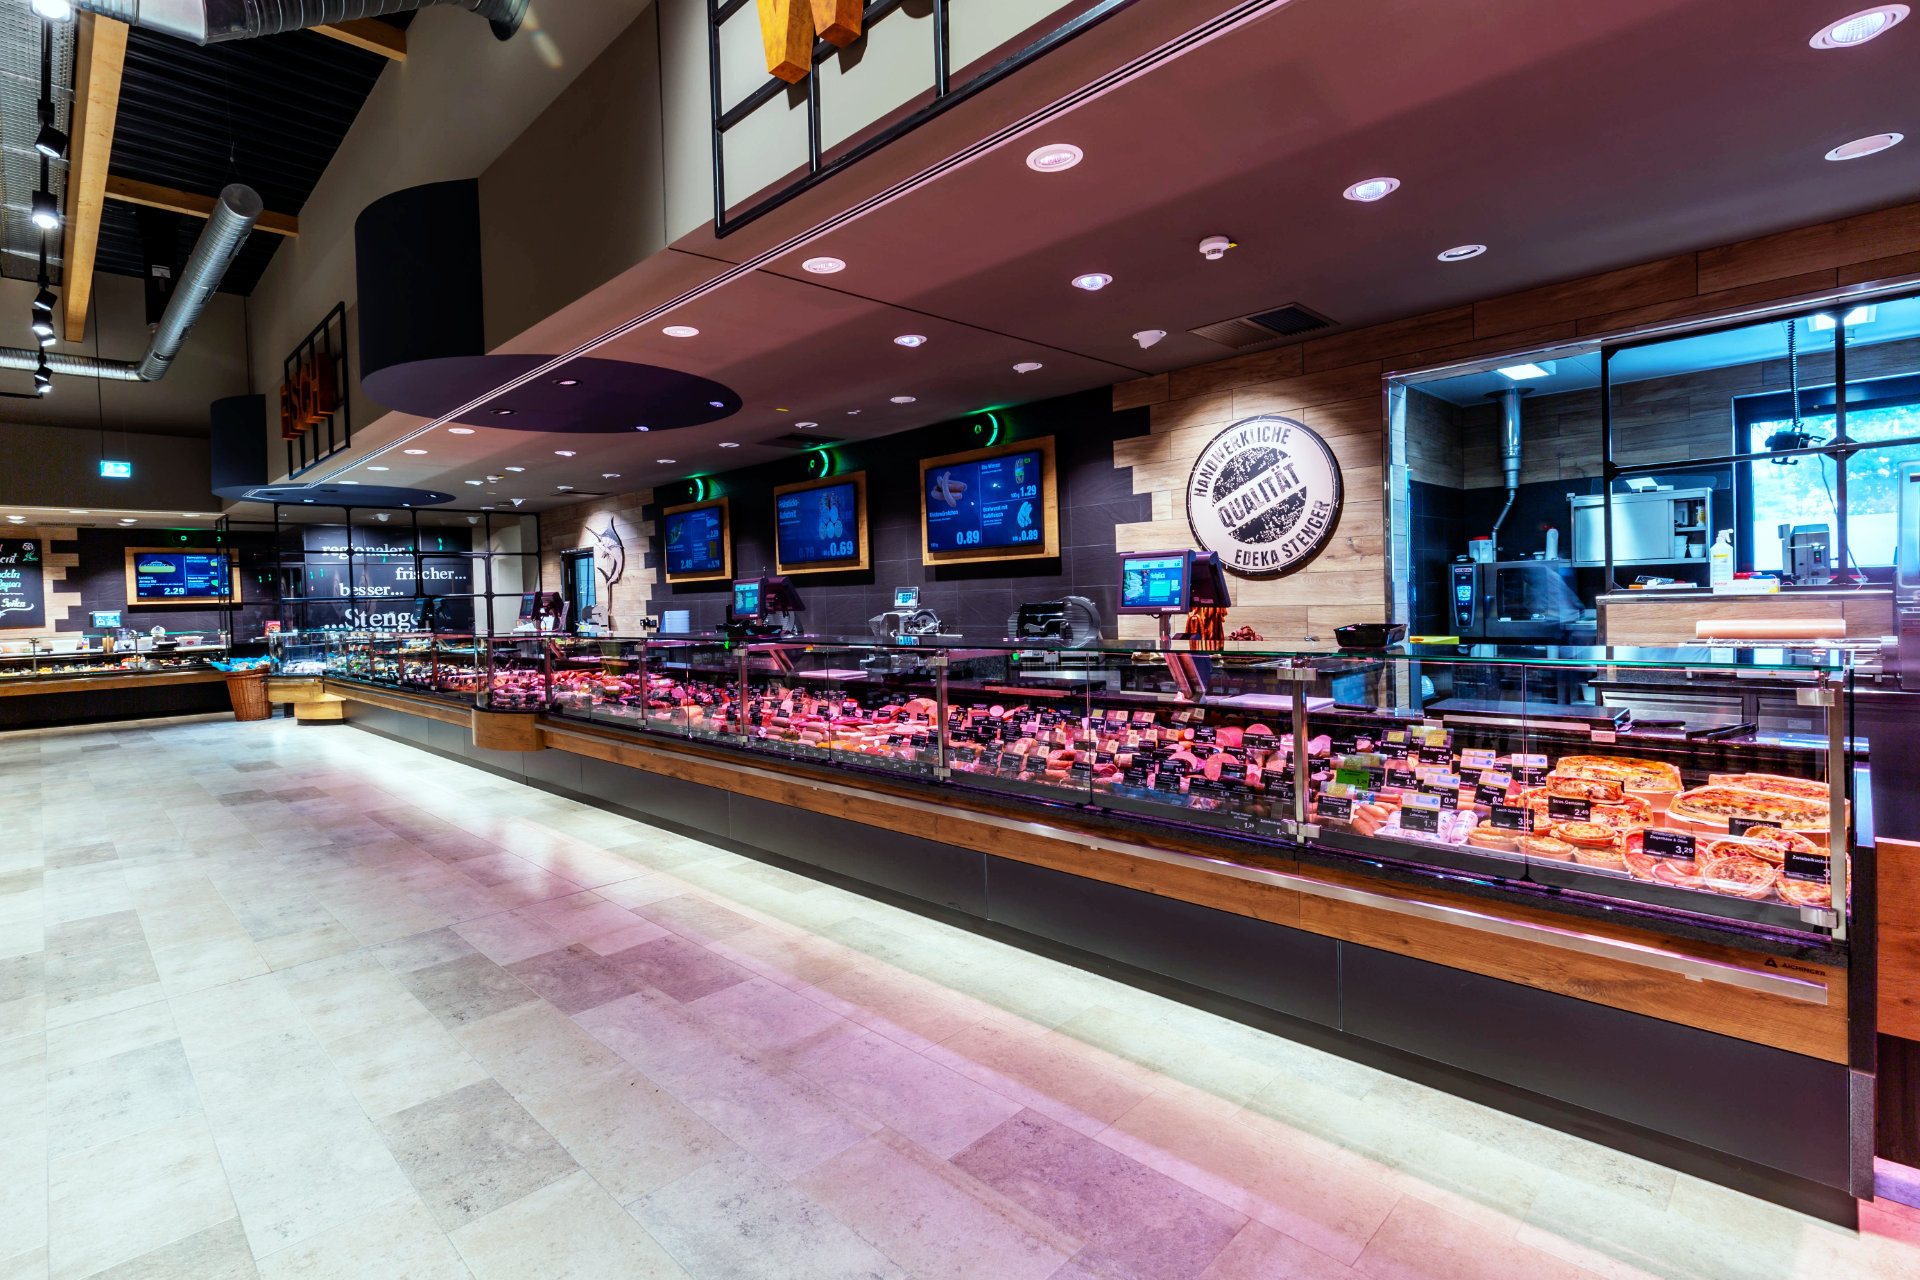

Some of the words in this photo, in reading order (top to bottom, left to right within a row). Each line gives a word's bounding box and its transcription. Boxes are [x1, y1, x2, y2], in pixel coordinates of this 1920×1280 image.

[1193, 425, 1291, 498] HANDWERKLICHE
[1020, 484, 1037, 497] 1.29
[1217, 462, 1301, 529] QUALITÄT
[956, 530, 980, 545] 0.89
[1021, 529, 1038, 541] 0.89
[1234, 549, 1280, 567] EDEKA
[1283, 499, 1331, 560] STENGER
[321, 543, 417, 560] regonaler..
[830, 540, 854, 557] 0.69
[395, 566, 467, 580] frischer...
[164, 587, 185, 595] 2.29
[338, 582, 404, 596] besser...
[323, 608, 420, 629] ...Stenge
[1734, 819, 1755, 827] Spargel
[1675, 845, 1694, 855] 3,29
[1781, 962, 1826, 976] AICHINGER
